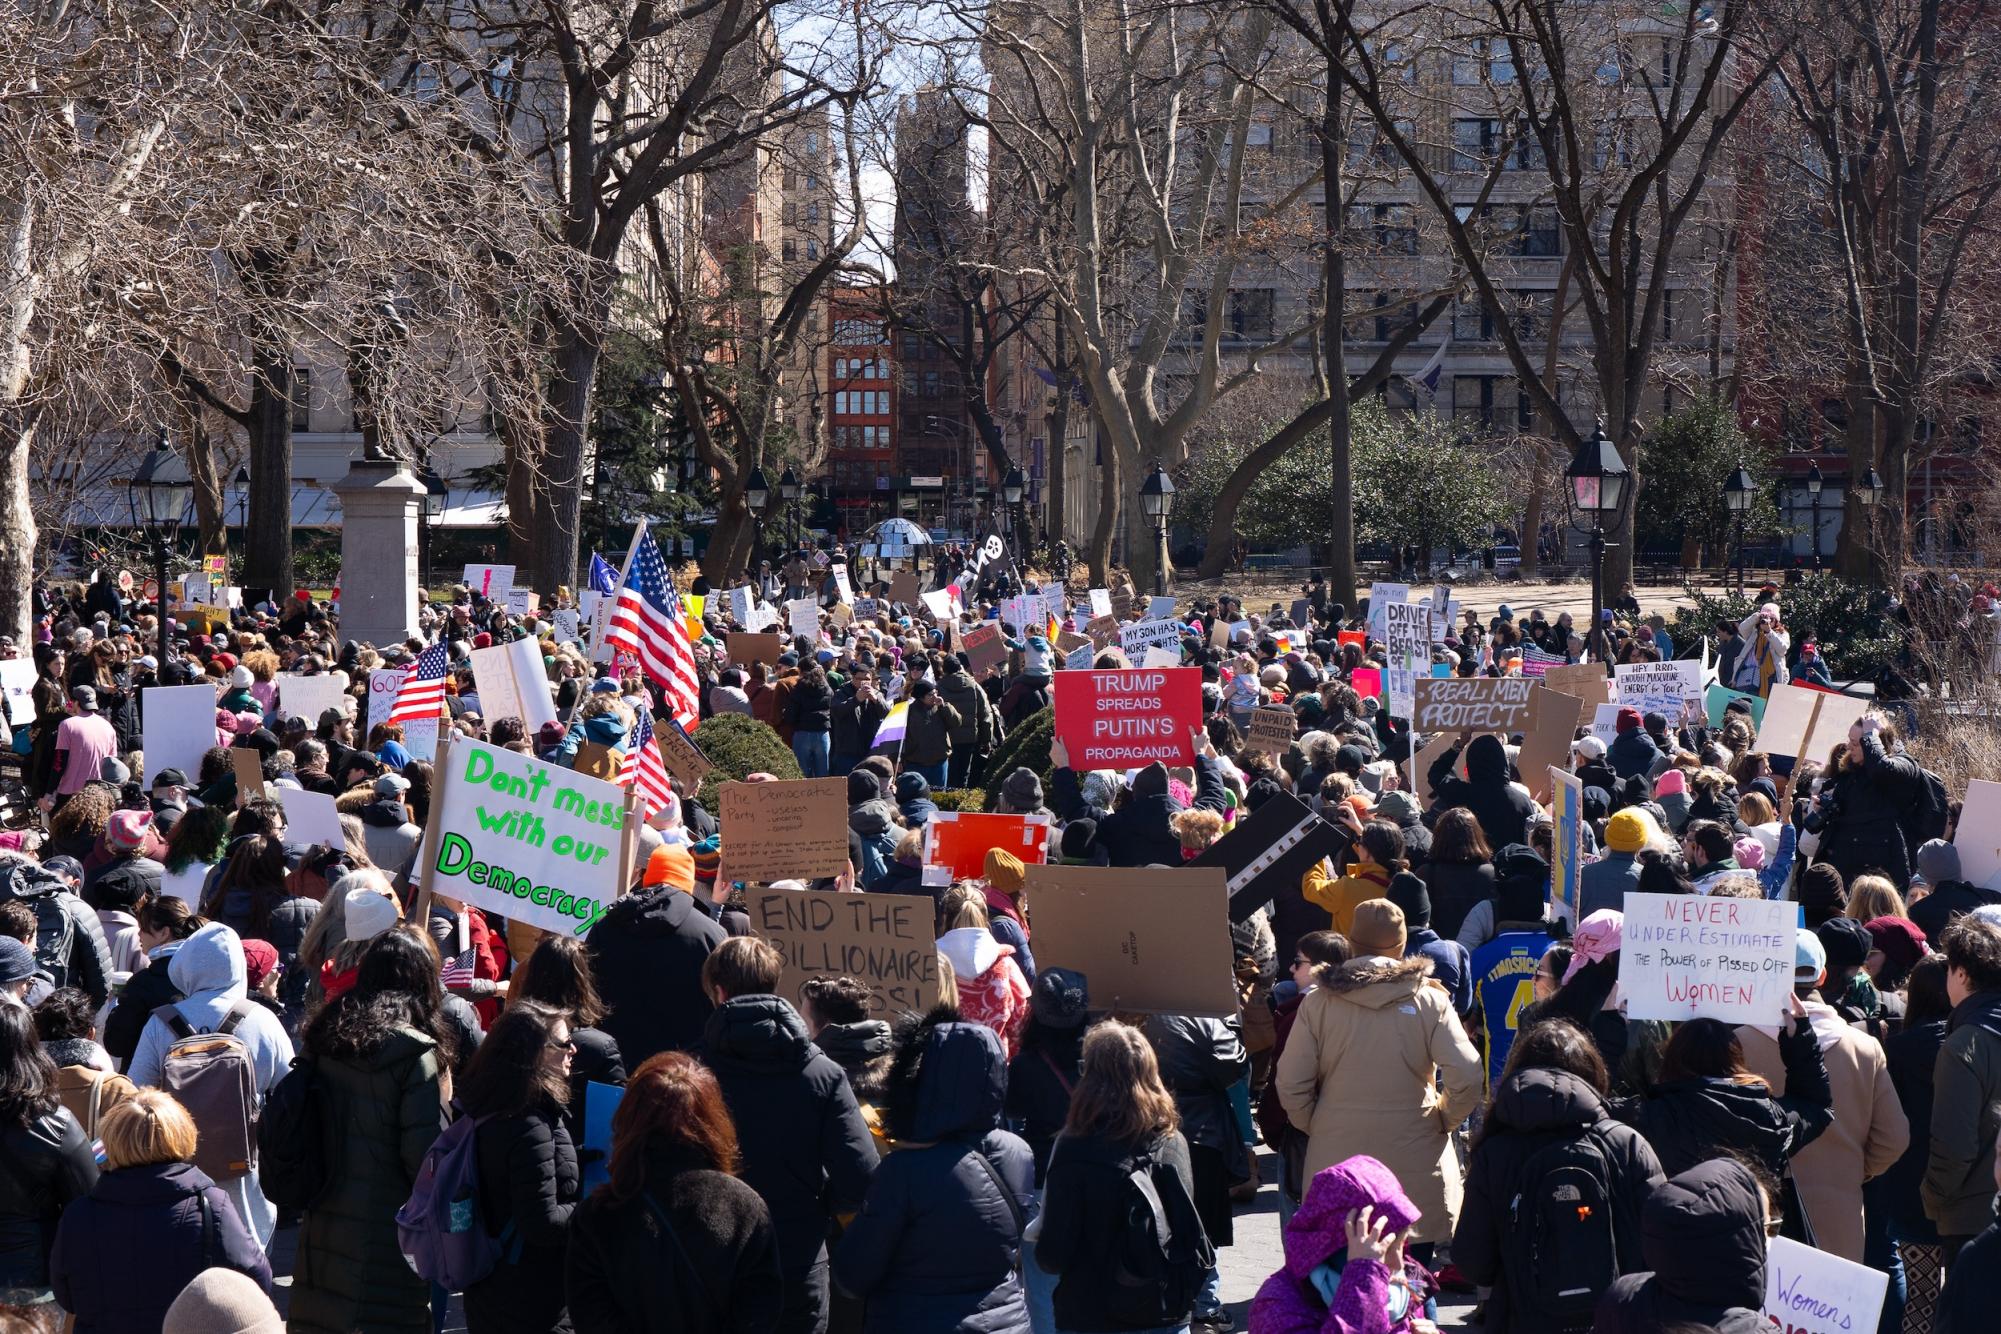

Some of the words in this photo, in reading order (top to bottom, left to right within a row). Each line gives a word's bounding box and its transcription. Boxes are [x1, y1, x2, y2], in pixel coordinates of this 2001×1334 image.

[1388, 604, 1426, 625] DRIVE
[1125, 628, 1139, 642] MY
[1139, 625, 1157, 639] SON
[1158, 622, 1177, 636] HAS
[1388, 623, 1409, 638] OFF
[1124, 641, 1149, 656] MORE
[1389, 636, 1429, 660] BEAST
[1129, 656, 1147, 668] THA
[1391, 655, 1405, 670] OF
[1092, 674, 1166, 692] TRUMP
[1428, 679, 1487, 702] REAL
[1490, 679, 1535, 703] MEN
[1096, 697, 1162, 711] SPREADS
[1095, 717, 1174, 737] PUTIN'S
[1254, 711, 1292, 727] UNPAID
[1249, 723, 1291, 740] PROTESTER
[660, 731, 702, 774] TRUMP
[1085, 746, 1181, 760] PROPAGANDA
[464, 748, 551, 804] Don't
[552, 787, 625, 831] mess
[721, 787, 751, 806] The
[758, 785, 834, 803] Democratic
[726, 807, 756, 823] Party
[475, 805, 547, 849] with
[551, 834, 610, 866] our
[435, 831, 610, 936] Democracy
[760, 894, 834, 932] END
[846, 900, 914, 940] THE
[1664, 899, 1742, 927] NEVER
[769, 937, 937, 983] BILLIONAIRE
[1634, 952, 1651, 967] THE
[1700, 957, 1712, 968] OF
[1762, 957, 1790, 974] OFF
[1504, 979, 1536, 1031] 4
